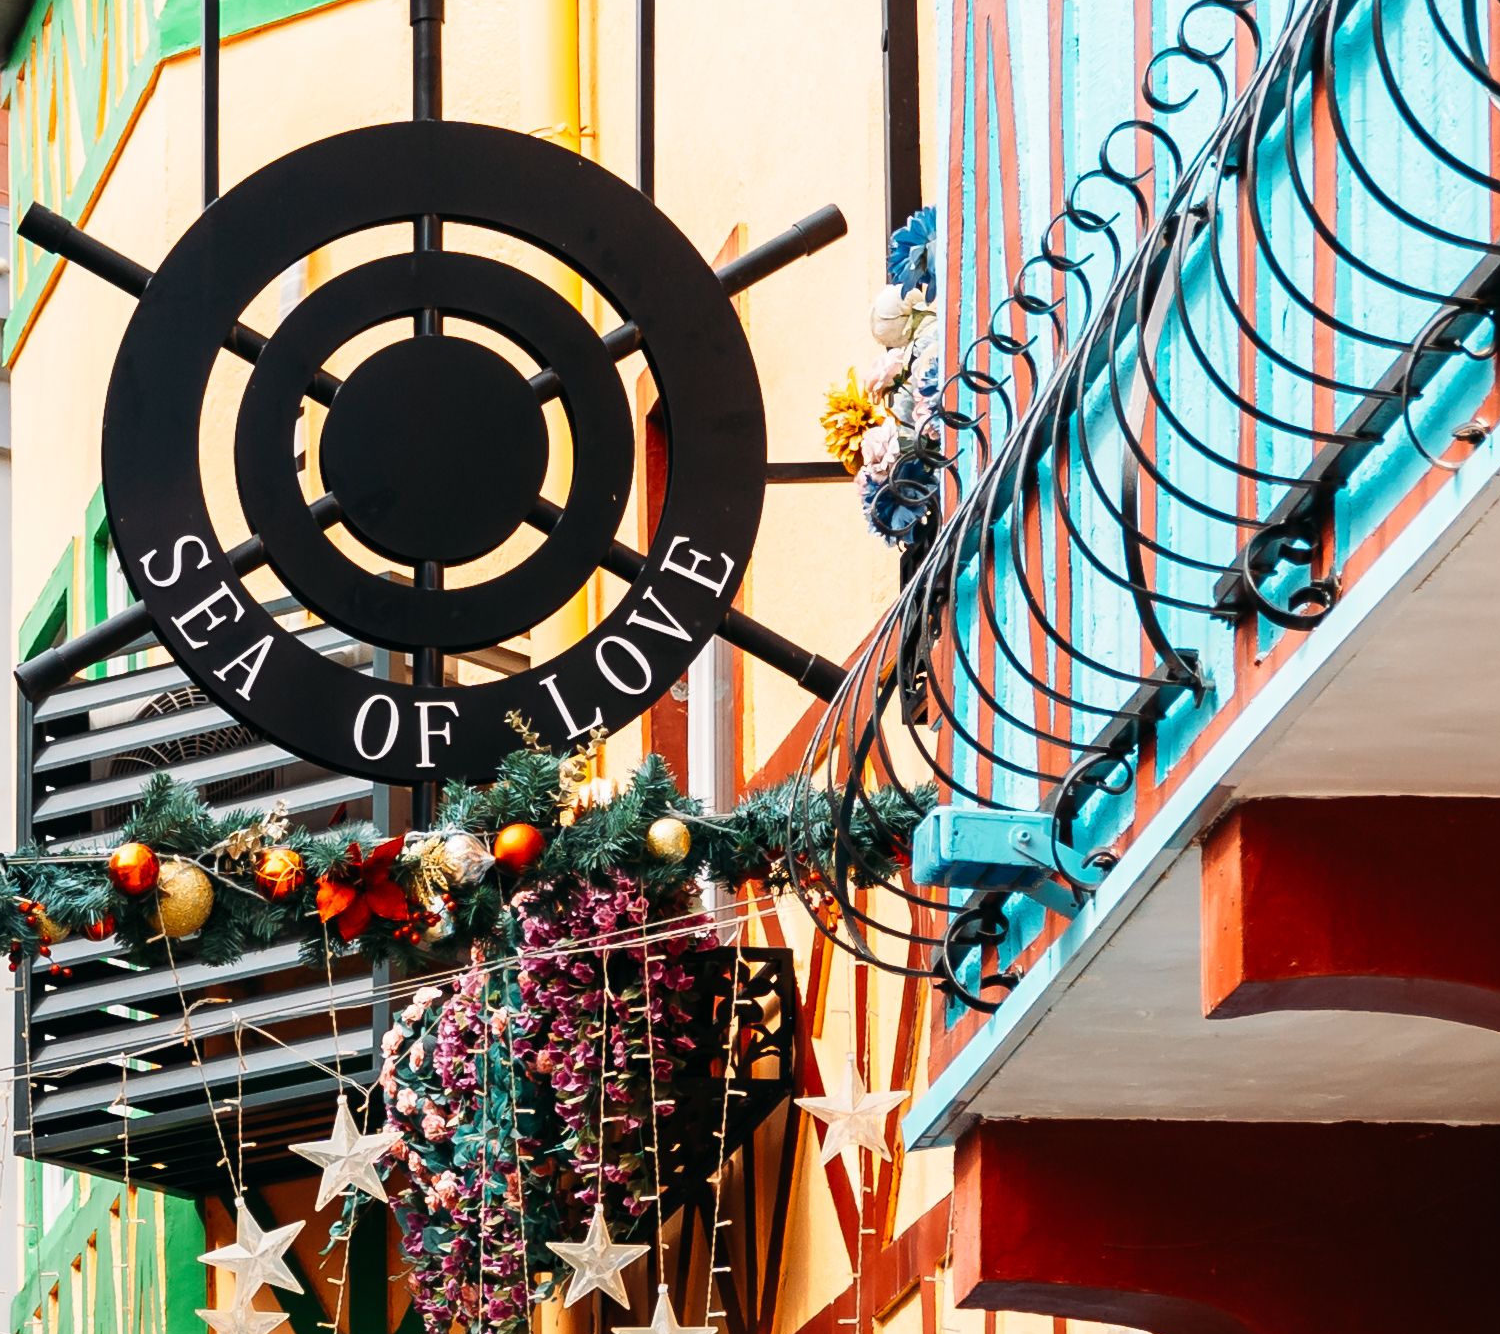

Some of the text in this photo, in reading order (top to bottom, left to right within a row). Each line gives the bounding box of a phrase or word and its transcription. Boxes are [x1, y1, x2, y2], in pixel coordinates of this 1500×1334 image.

[139, 534, 736, 768] SEA OF LOVE
